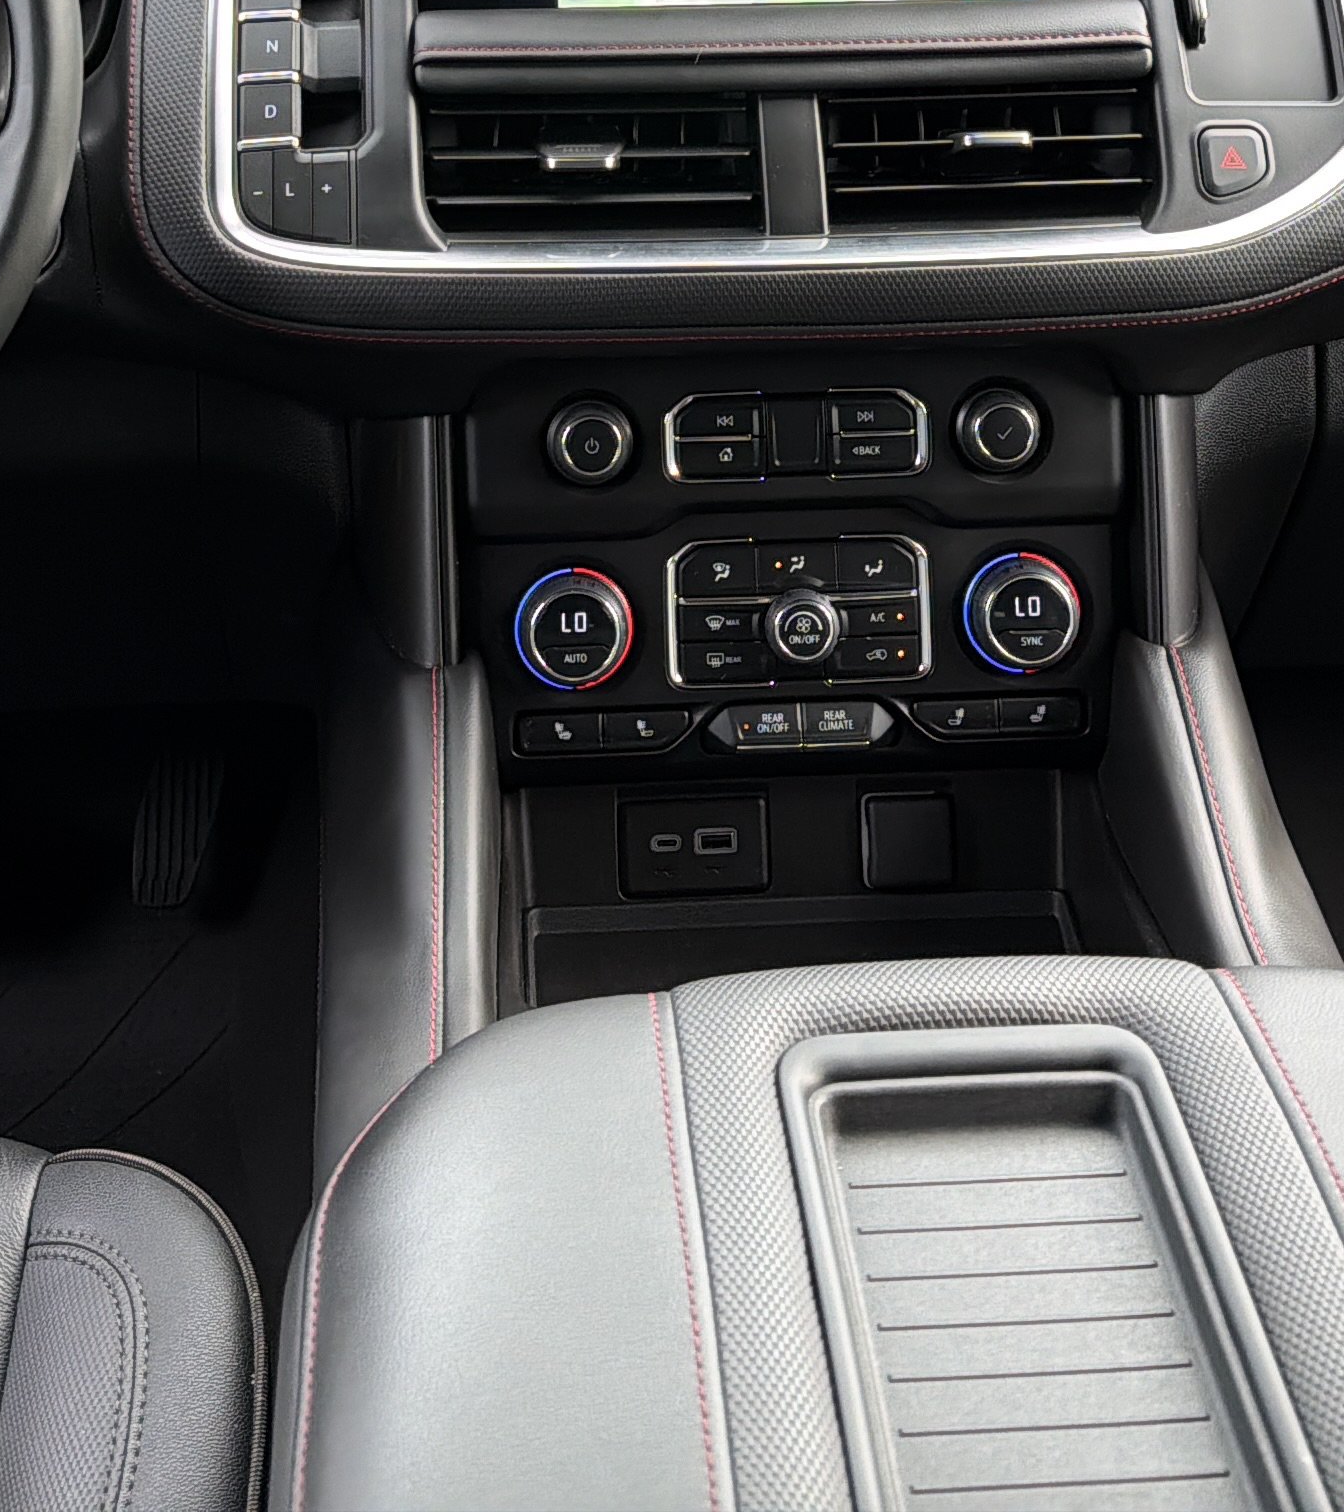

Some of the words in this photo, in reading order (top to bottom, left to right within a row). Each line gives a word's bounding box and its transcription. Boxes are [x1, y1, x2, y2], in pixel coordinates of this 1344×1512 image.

[266, 39, 279, 53] N
[264, 104, 277, 119] D
[285, 183, 295, 196] L
[859, 445, 881, 455] BACK
[1014, 596, 1041, 617] LO
[561, 612, 587, 633] LO
[725, 618, 740, 626] MAX
[870, 612, 886, 623] A/C
[788, 634, 821, 645] ON/OFF
[1021, 636, 1044, 647] SYNC
[564, 654, 588, 663] AUTO
[725, 656, 742, 664] REAR
[761, 713, 784, 723] REAR
[824, 710, 846, 720] REAR
[757, 723, 790, 733] ON/OFF
[818, 720, 854, 731] CLIMATE
